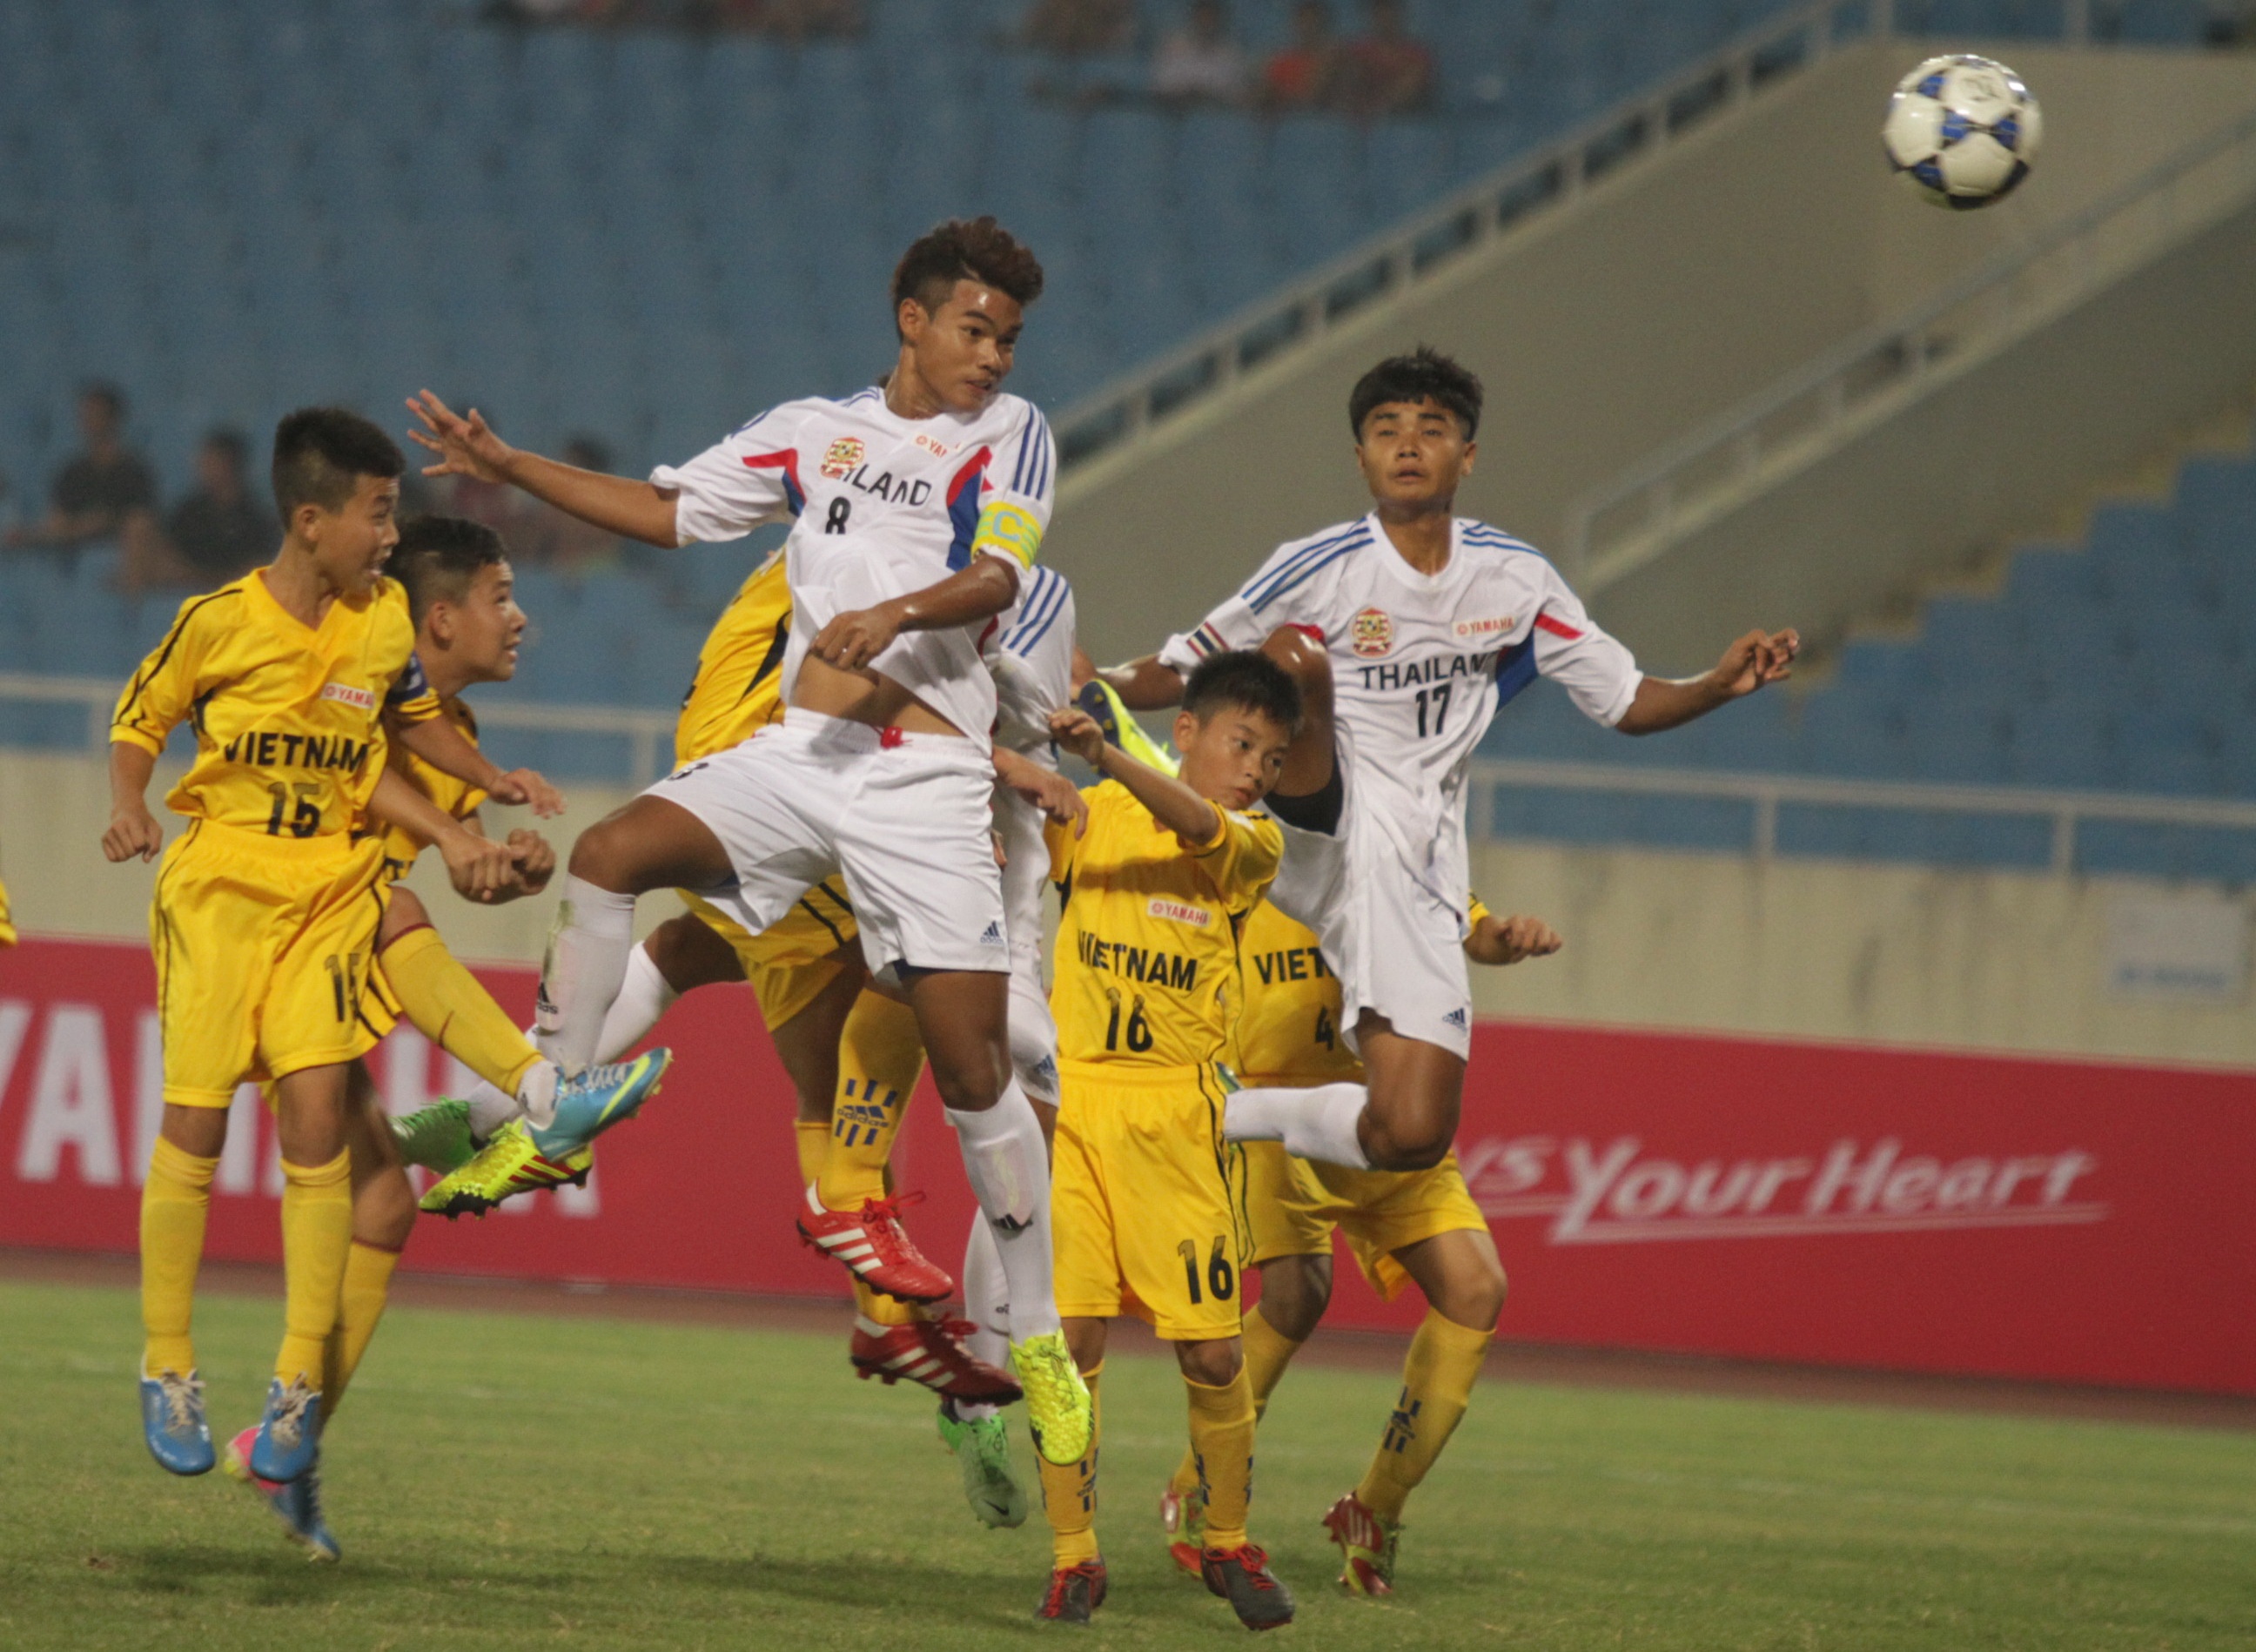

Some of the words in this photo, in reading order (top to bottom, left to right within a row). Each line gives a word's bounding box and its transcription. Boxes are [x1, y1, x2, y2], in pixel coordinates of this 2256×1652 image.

[825, 496, 851, 534] 8
[993, 511, 1024, 543] C
[1470, 616, 1514, 634] YAMAHA
[1416, 684, 1452, 737] 17
[225, 731, 368, 773] VIETNAM
[267, 782, 320, 838] 15
[1166, 903, 1210, 925] YAMAHA
[1105, 987, 1153, 1052] 16
[1315, 1004, 1334, 1051] 4
[1548, 1134, 1815, 1244] Your
[1804, 1135, 2098, 1216] Heart
[1178, 1234, 1233, 1305] 16
